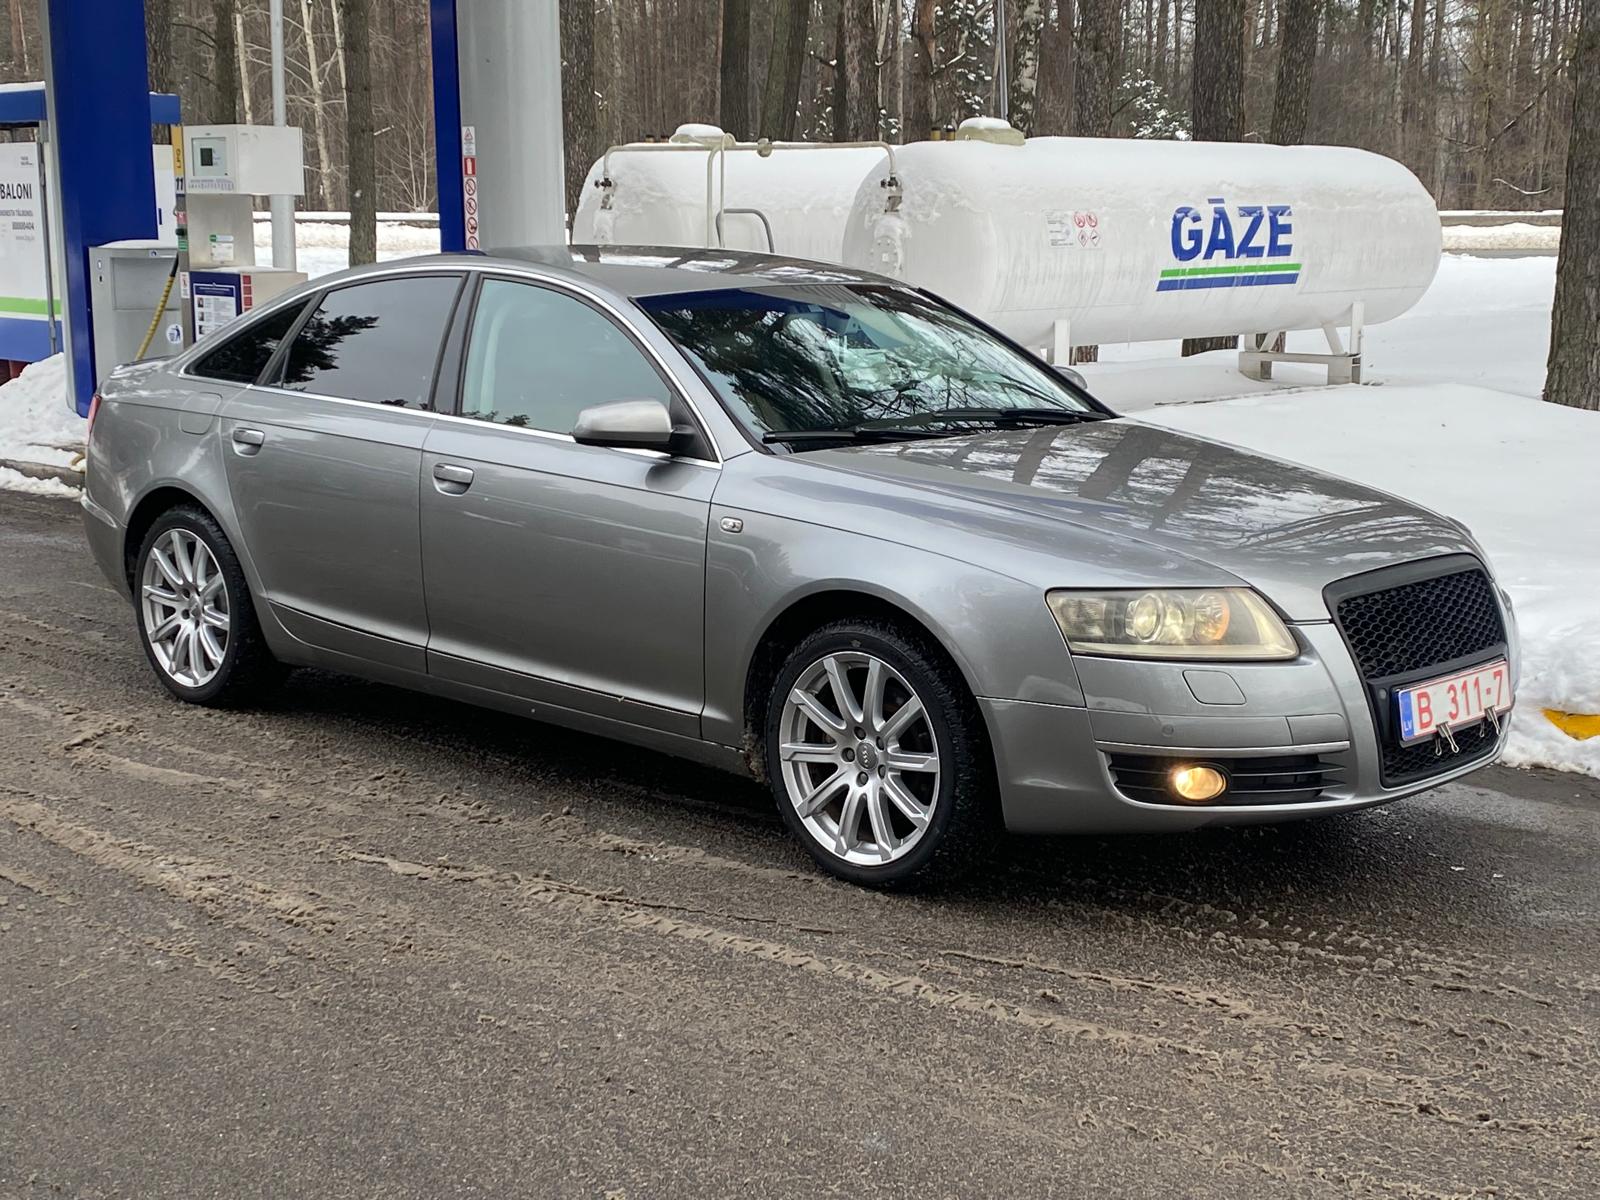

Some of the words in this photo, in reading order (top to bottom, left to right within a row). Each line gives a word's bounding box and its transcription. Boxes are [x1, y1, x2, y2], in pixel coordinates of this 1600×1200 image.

[0, 183, 33, 200] BALONI
[175, 177, 183, 191] 11
[1171, 198, 1293, 262] GĀZE
[1417, 691, 1433, 729] B
[1403, 719, 1412, 731] LV
